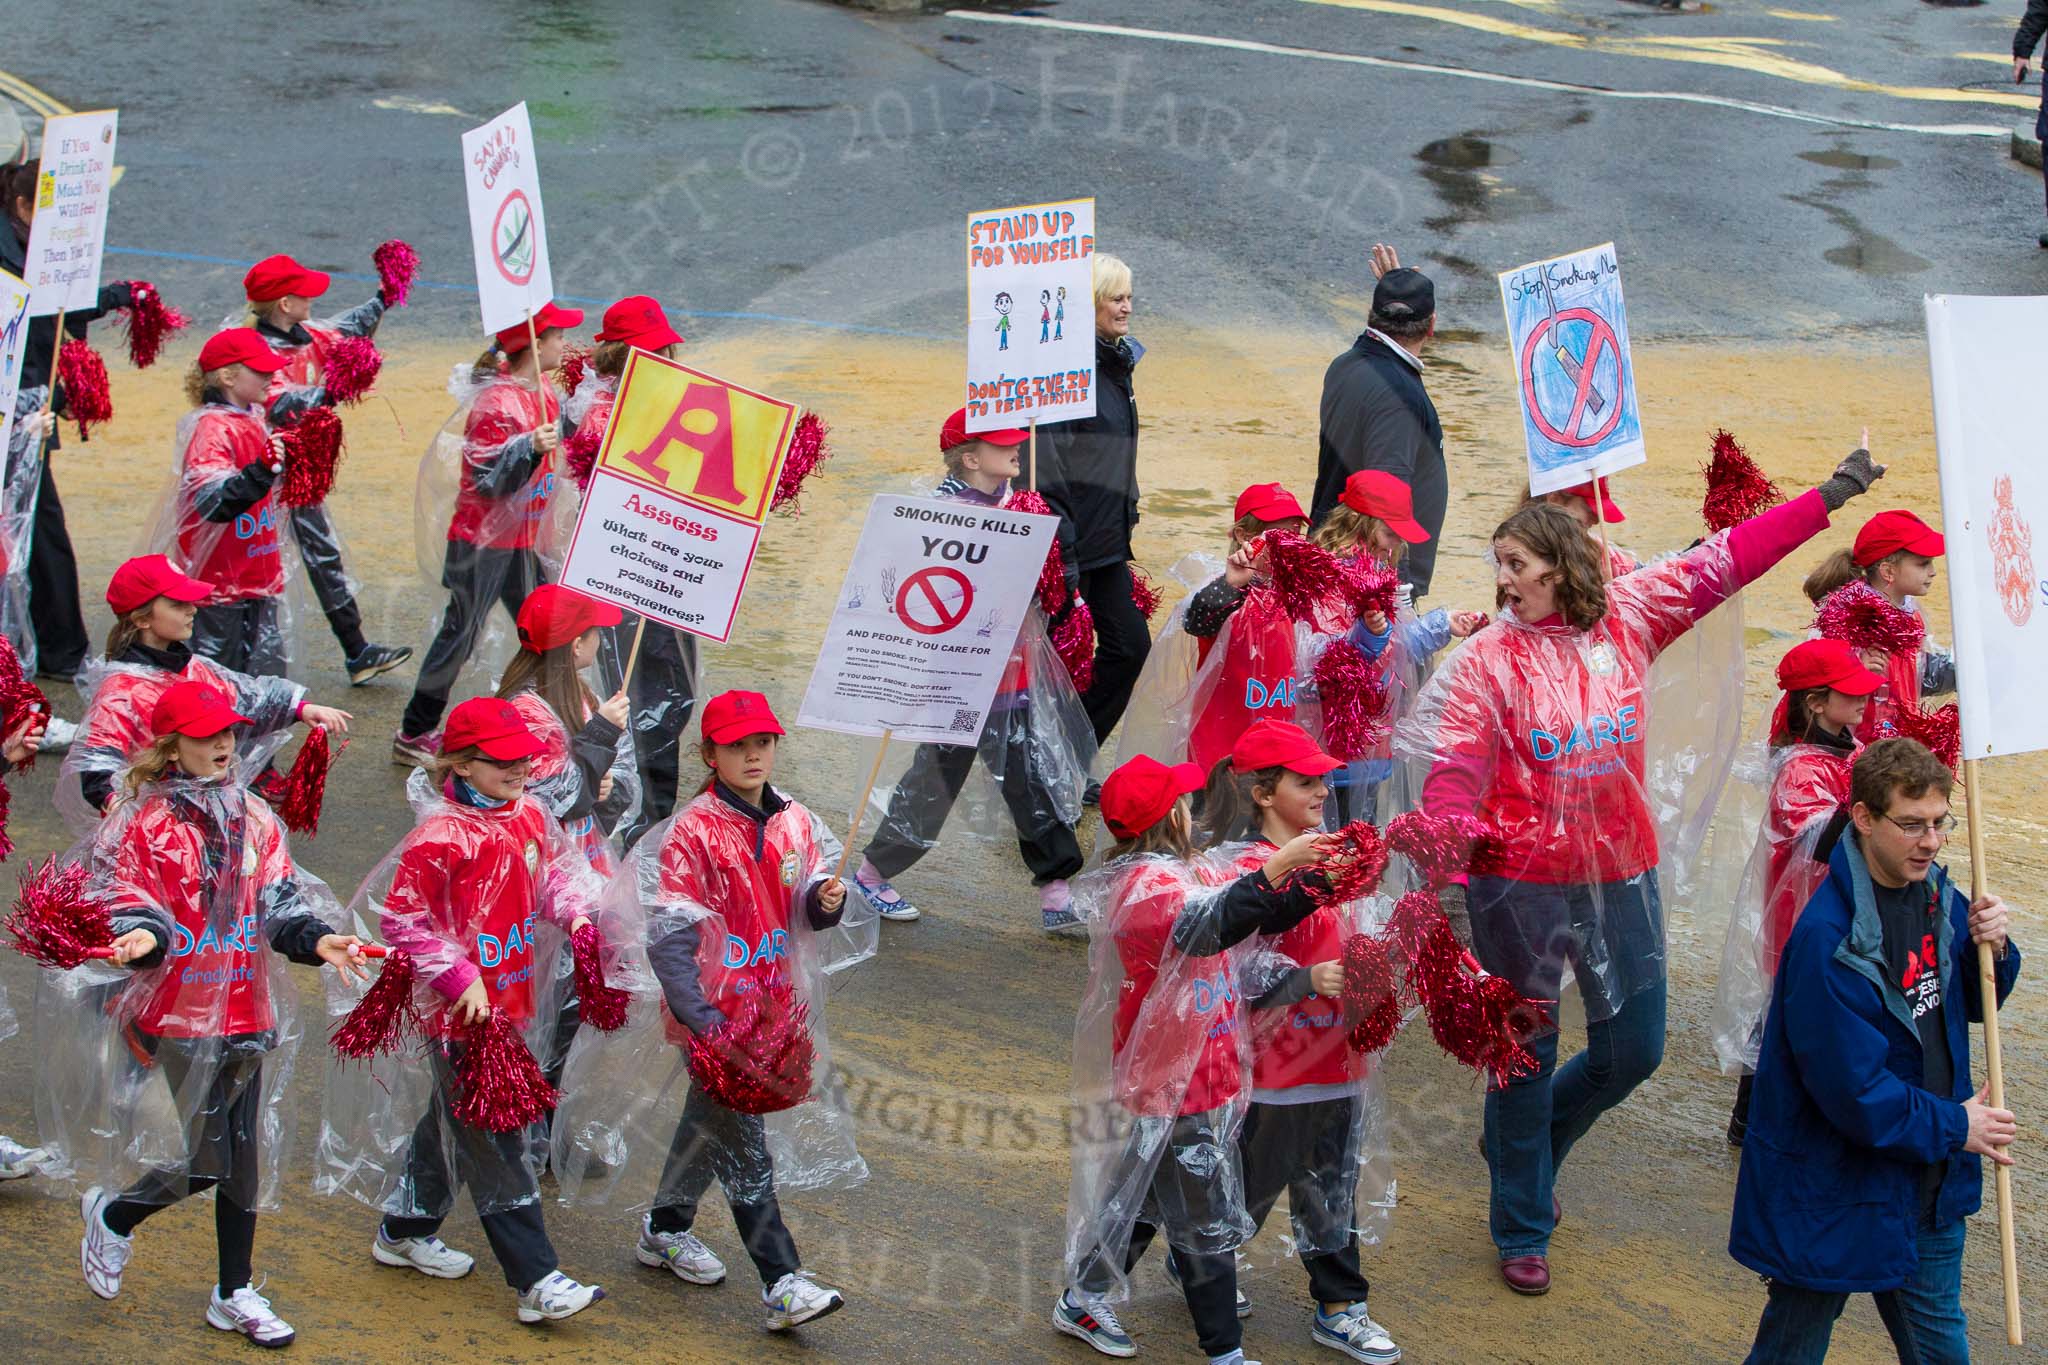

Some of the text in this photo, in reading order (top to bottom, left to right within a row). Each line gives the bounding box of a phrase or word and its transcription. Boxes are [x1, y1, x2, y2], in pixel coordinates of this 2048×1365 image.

[970, 210, 1075, 245] STAND UP
[971, 234, 1094, 267] FOR YOURSELF
[1511, 271, 1543, 300] Stop
[1547, 263, 1600, 290] Smoking
[968, 400, 988, 417] TO
[995, 395, 1033, 414] PEER
[622, 382, 748, 506] A
[235, 503, 277, 539] DA
[622, 493, 719, 542] Assess
[893, 505, 1032, 537] SMOKING KILLS
[602, 518, 724, 572] What are your
[921, 535, 989, 565] YOU
[610, 543, 704, 585] choices and
[586, 576, 705, 625] consequences?
[617, 567, 684, 600] possible
[846, 629, 991, 655] AND PEOPLE YOU CARE FOR
[1245, 676, 1297, 710] DAR
[1530, 705, 1636, 761] DARE
[722, 928, 789, 969] DAR
